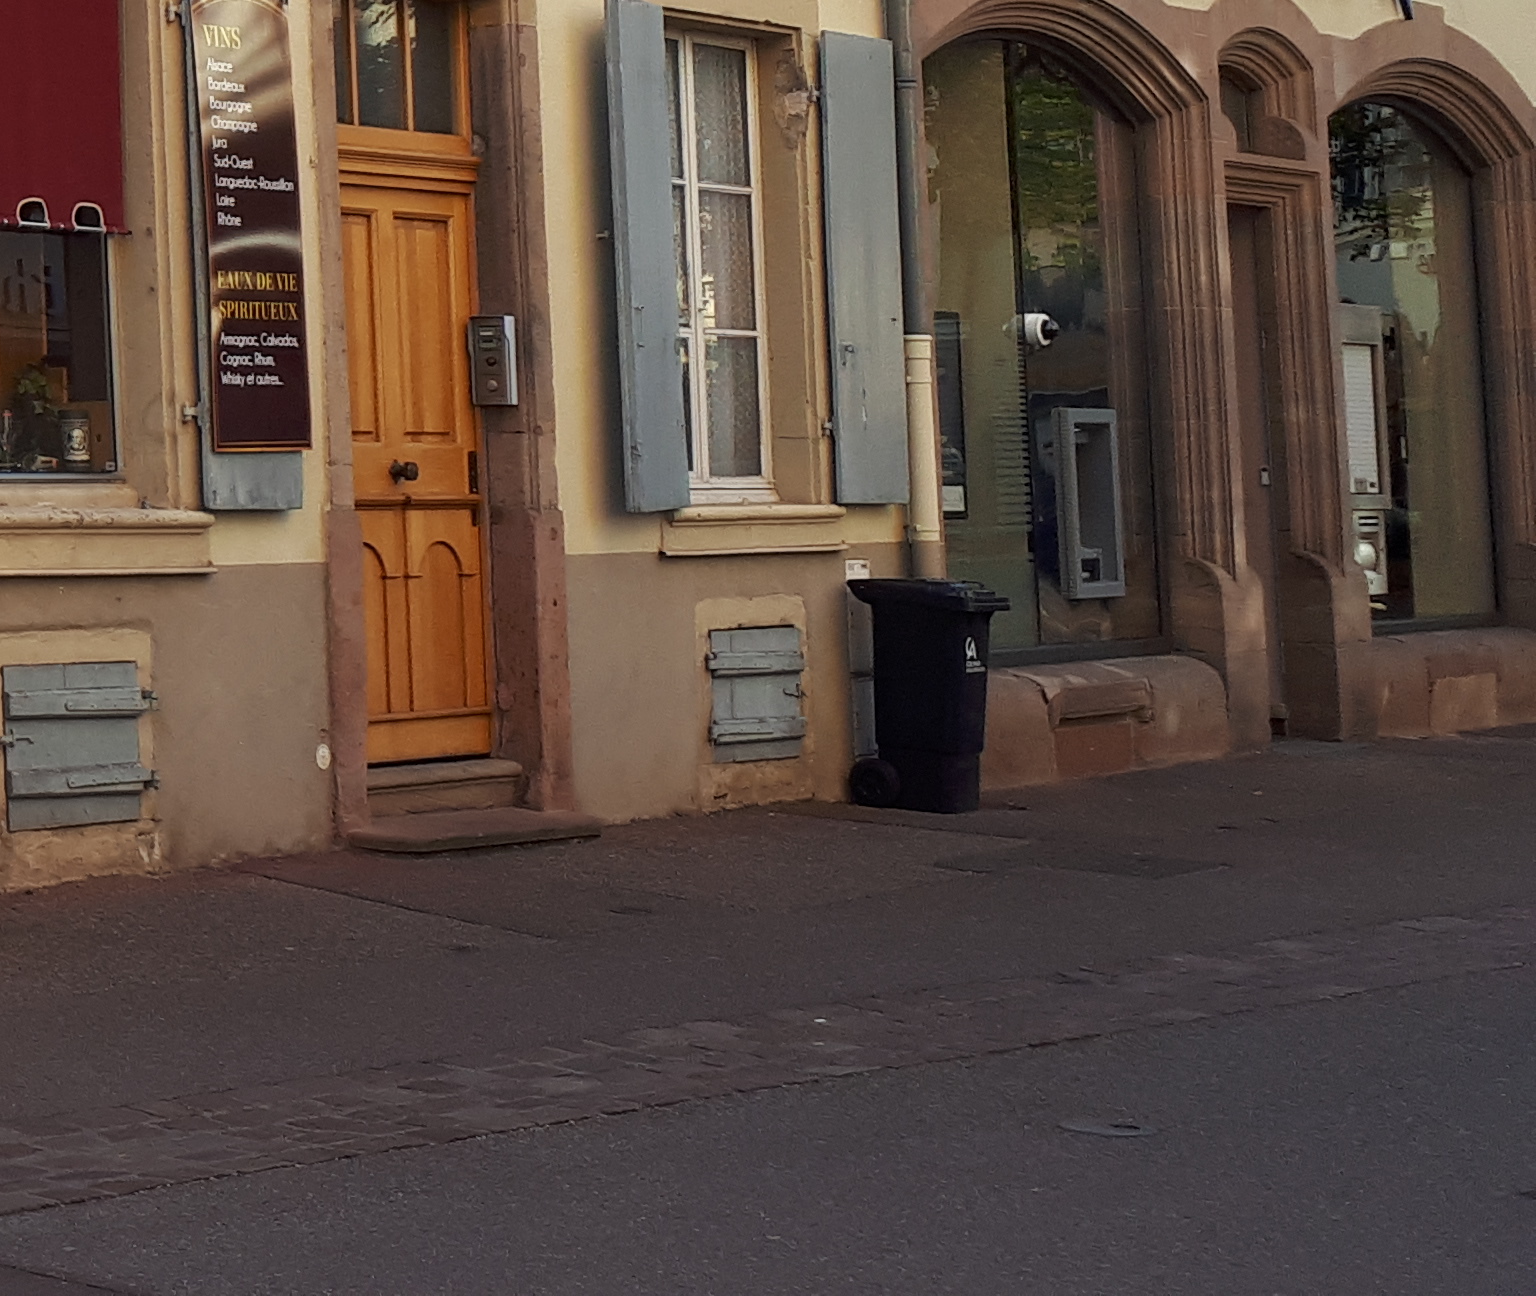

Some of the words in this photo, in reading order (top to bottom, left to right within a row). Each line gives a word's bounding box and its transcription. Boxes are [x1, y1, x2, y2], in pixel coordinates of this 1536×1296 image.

[203, 24, 241, 50] VINS
[207, 57, 233, 73] Alsace
[208, 76, 245, 93] Bordeaux
[210, 95, 253, 114] Bourgogne
[211, 115, 258, 133] Champagne
[212, 135, 228, 150] Jura
[214, 153, 254, 170] Sud-Ouest
[215, 173, 295, 192] Languedoc-Roussillon
[216, 192, 236, 207] Loire
[217, 270, 254, 290] EAUX
[256, 272, 274, 291] DE
[276, 273, 298, 292] VIE
[219, 300, 299, 321] SPIRITUEUX
[220, 371, 245, 388] Whisky
[246, 372, 255, 385] et
